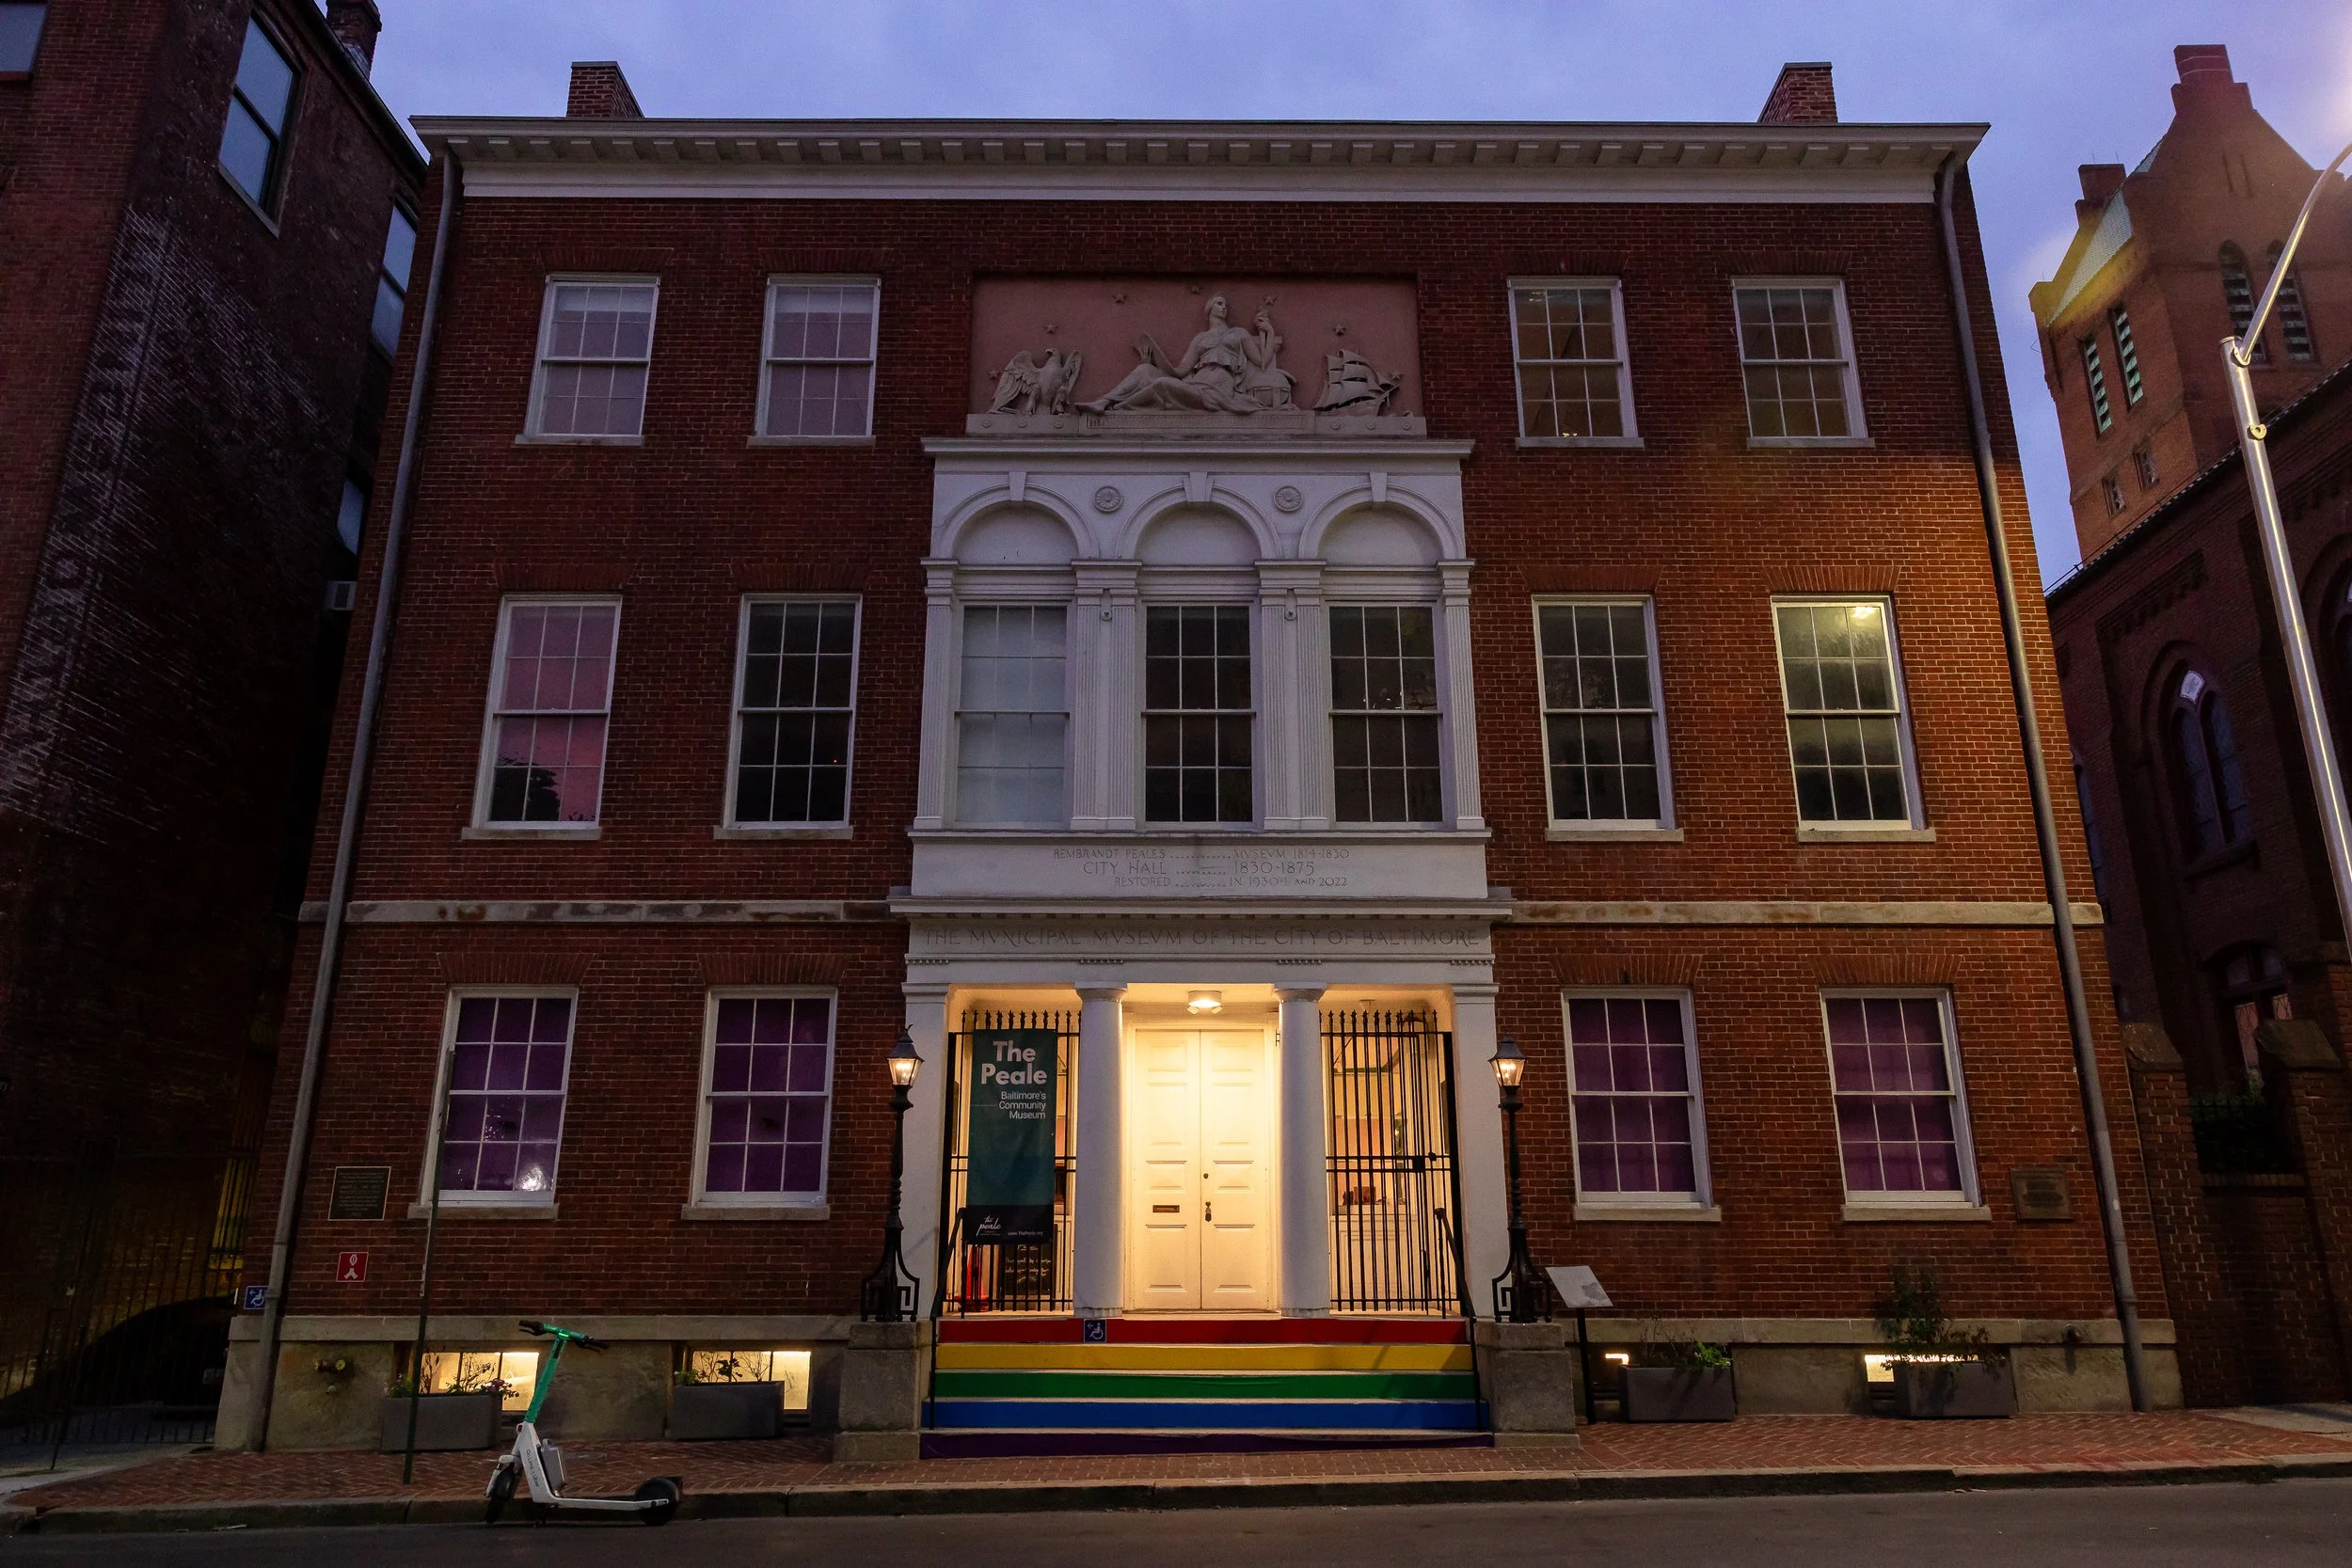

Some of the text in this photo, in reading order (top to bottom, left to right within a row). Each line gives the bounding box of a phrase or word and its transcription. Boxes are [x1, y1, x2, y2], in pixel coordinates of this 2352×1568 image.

[1053, 848, 1119, 860] REMBRANDT
[1294, 848, 1350, 859] 1814-1830
[1083, 860, 1315, 876] CITY HALL 1830-1875
[1114, 877, 1171, 887] RESTORED
[1230, 877, 1243, 887] IN
[1319, 877, 1348, 887] 2022
[925, 928, 961, 945] THE
[1191, 928, 1220, 945] OF
[1228, 927, 1266, 945] THE
[1273, 927, 1319, 945] CITY
[1327, 927, 1353, 945] OF
[1362, 927, 1480, 947] BALTIMORE
[993, 1039, 1037, 1062] The
[981, 1062, 1047, 1085] Peale
[1001, 1090, 1046, 1100] Baltimore's
[998, 1101, 1046, 1111] Community
[1009, 1111, 1046, 1119] Museum
